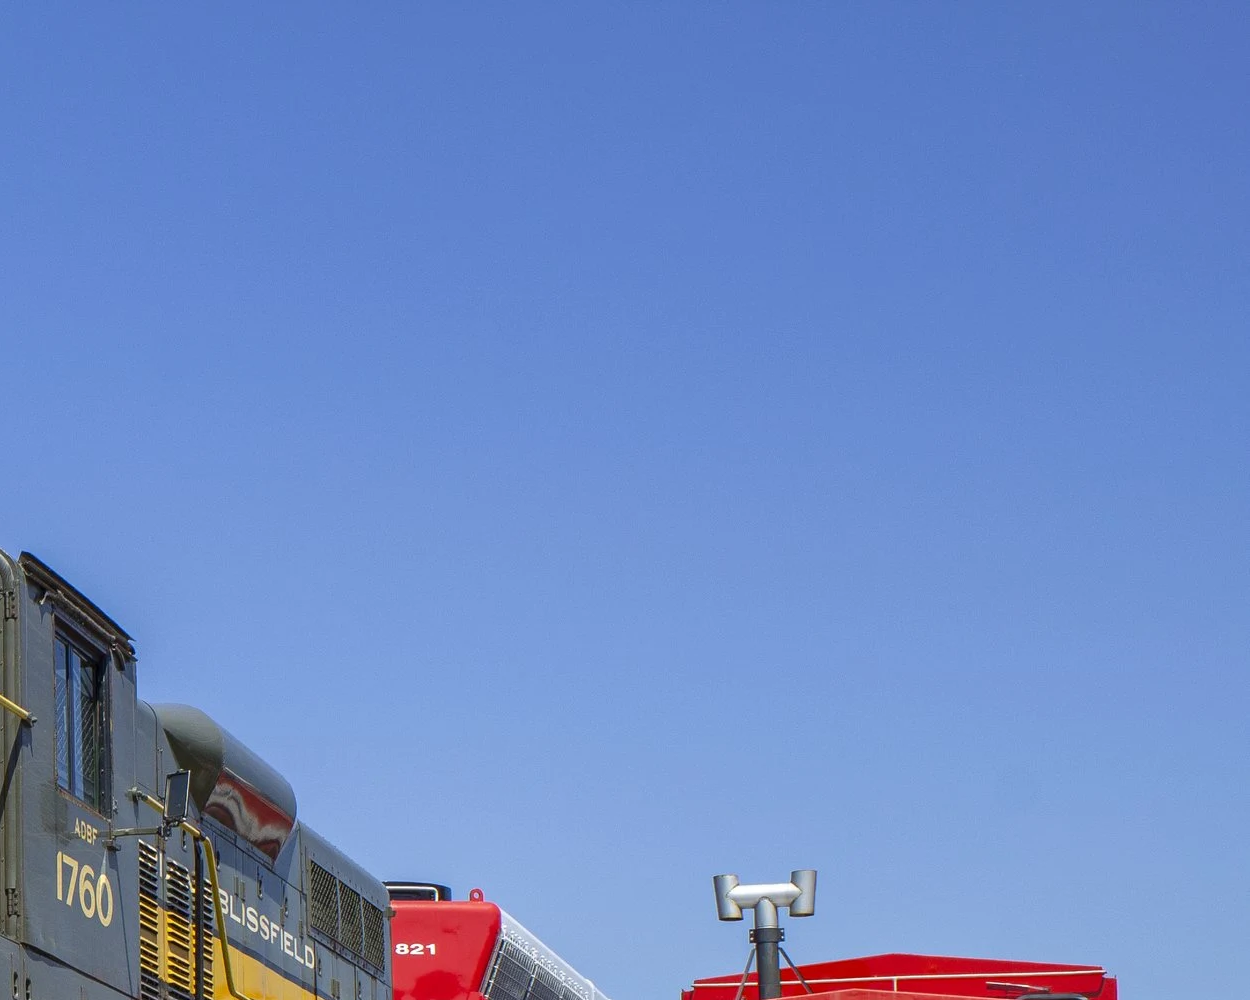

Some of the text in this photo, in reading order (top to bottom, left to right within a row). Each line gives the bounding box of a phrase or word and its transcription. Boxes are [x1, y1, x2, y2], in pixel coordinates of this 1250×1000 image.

[74, 816, 98, 846] ADBF
[56, 850, 114, 927] 1760
[217, 887, 315, 970] BLISSFIELD
[394, 943, 436, 955] 821
